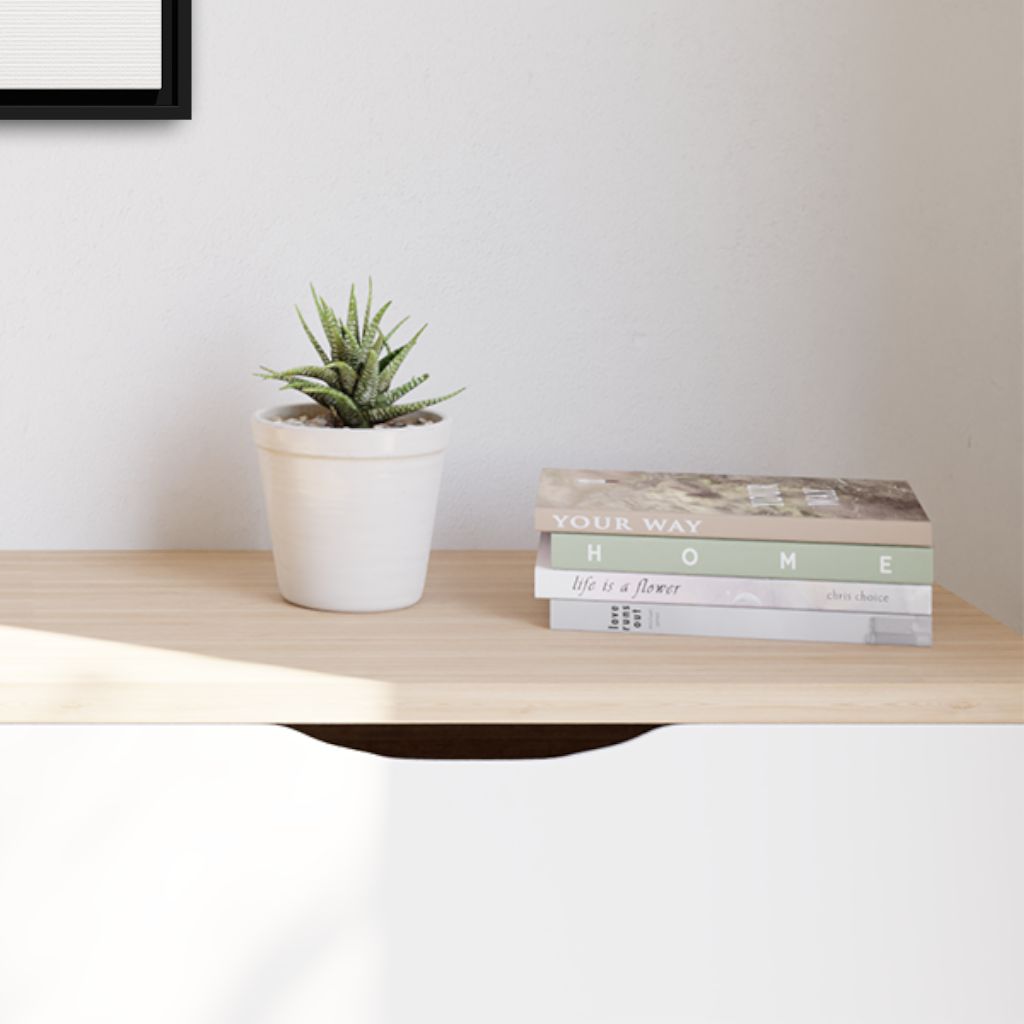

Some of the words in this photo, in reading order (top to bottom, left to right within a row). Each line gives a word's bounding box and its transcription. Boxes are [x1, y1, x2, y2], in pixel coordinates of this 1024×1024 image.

[552, 514, 632, 531] YOUR
[643, 518, 703, 533] WAY
[587, 543, 893, 574] HOME
[571, 575, 597, 597] life
[602, 579, 615, 593] is
[619, 582, 630, 593] a
[631, 577, 683, 599] flower
[826, 589, 852, 602] chris
[854, 589, 890, 604] choice
[608, 605, 619, 630] love
[622, 605, 630, 631] runs
[632, 609, 642, 629] out
